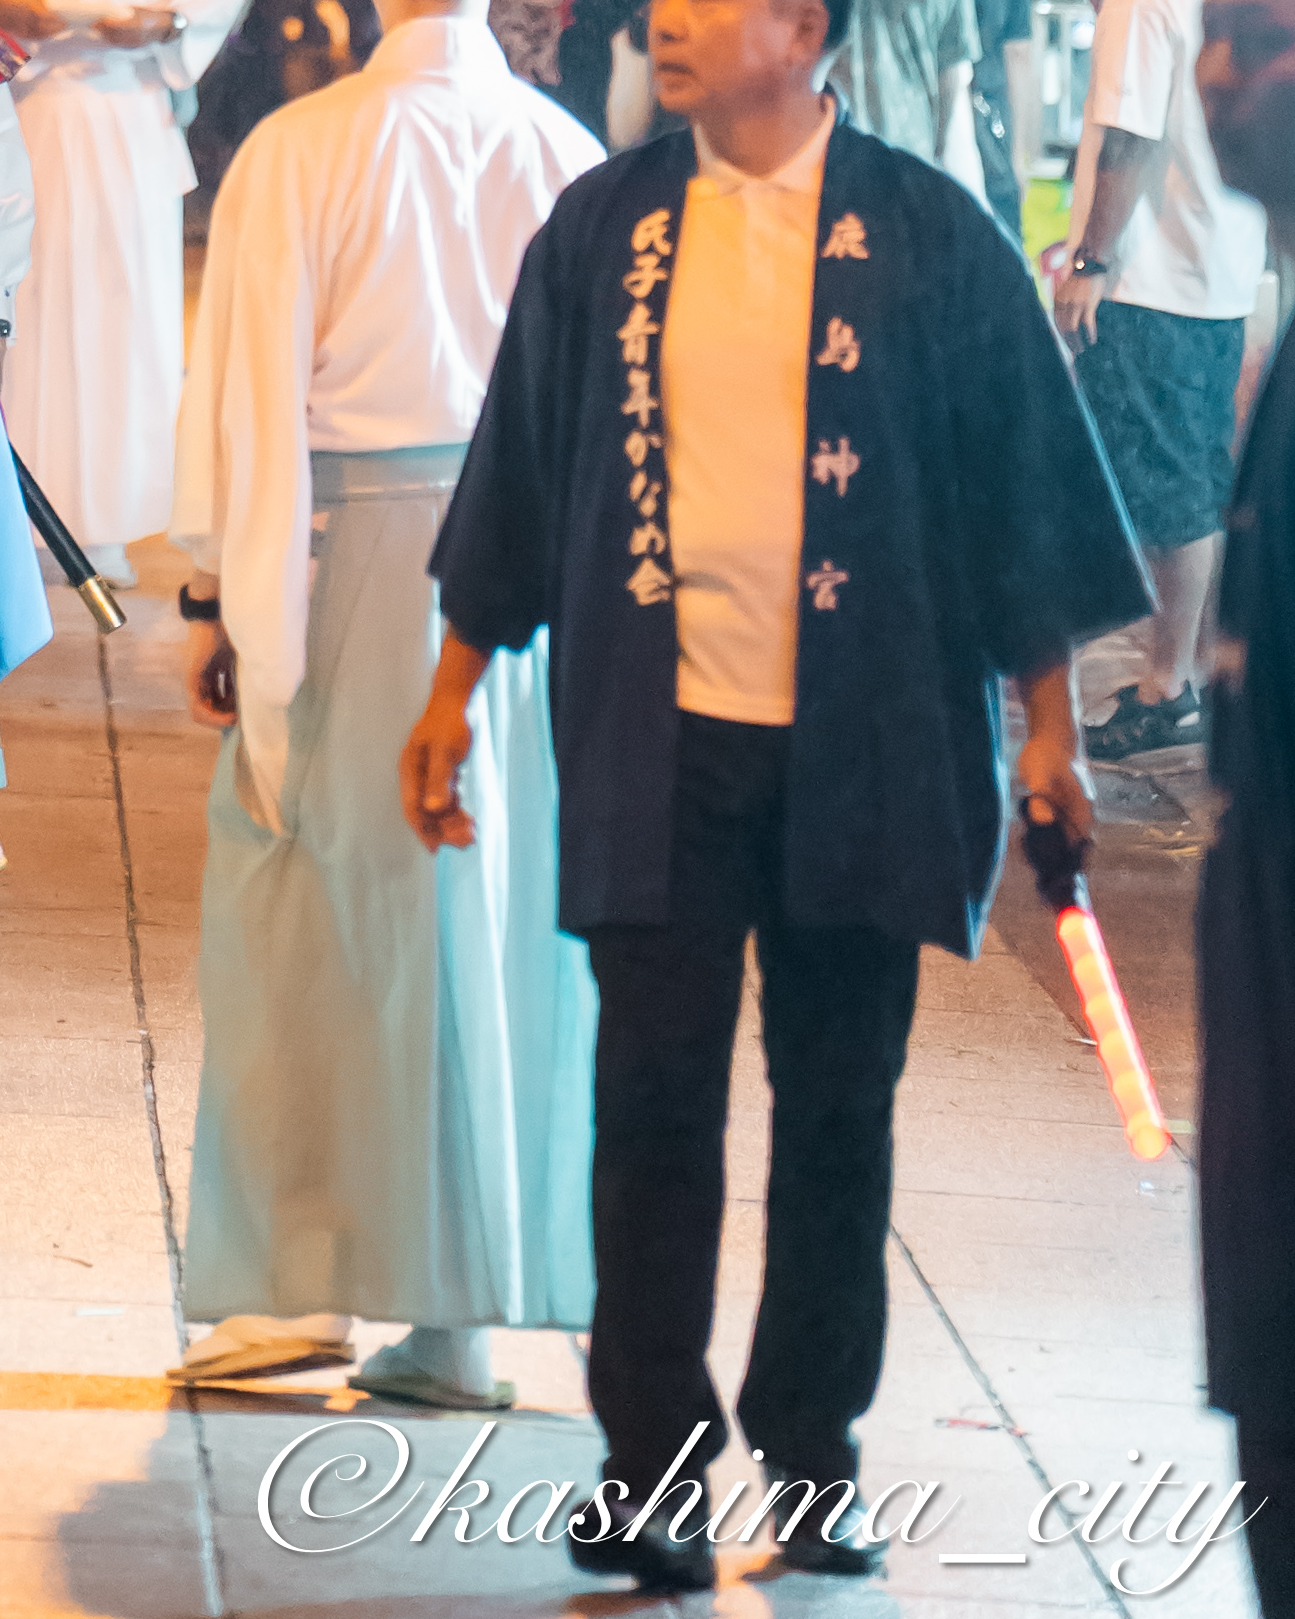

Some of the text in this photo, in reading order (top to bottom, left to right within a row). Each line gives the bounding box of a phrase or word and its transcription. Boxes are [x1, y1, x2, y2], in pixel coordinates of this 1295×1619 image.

[616, 207, 673, 608] 氏子青年かなめ会
[806, 211, 870, 611] 鹿島神宮
